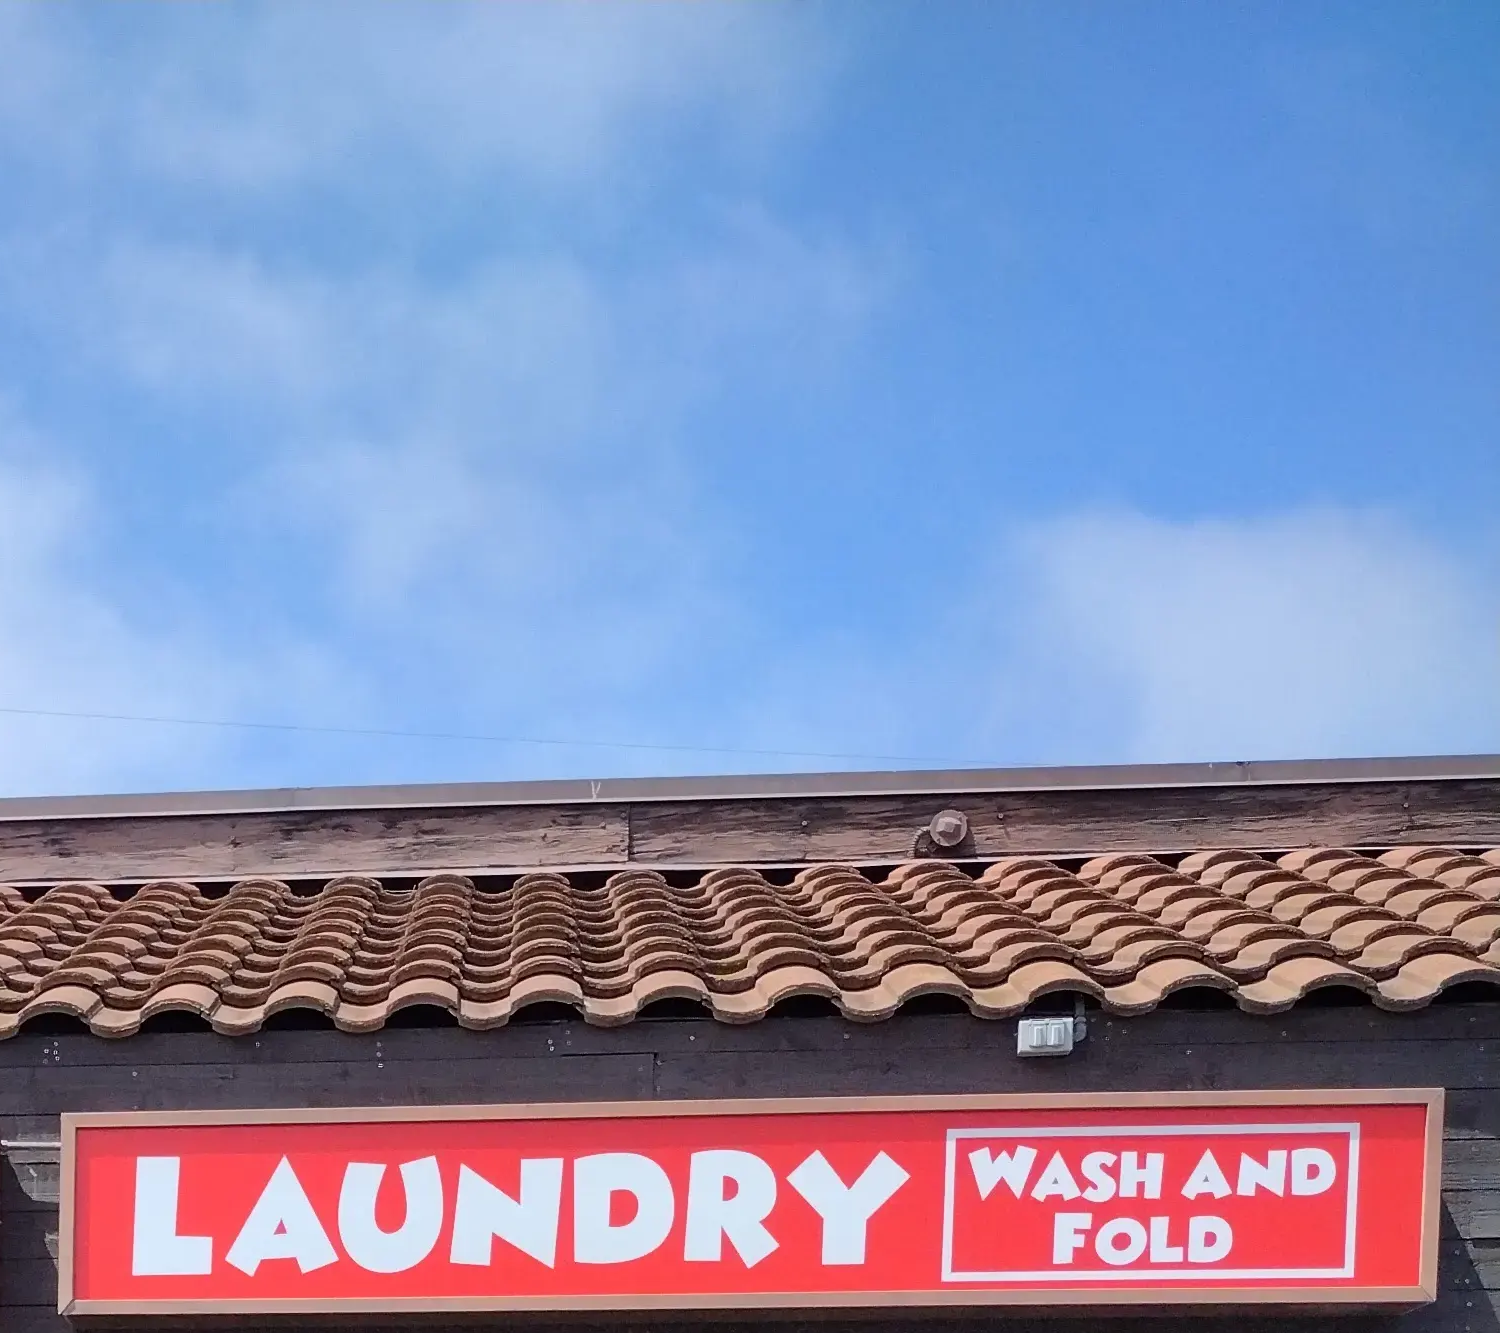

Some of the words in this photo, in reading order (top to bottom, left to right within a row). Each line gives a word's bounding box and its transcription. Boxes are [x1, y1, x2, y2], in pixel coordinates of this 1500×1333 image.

[967, 1145, 1165, 1203] WASH
[1180, 1147, 1337, 1200] AND
[131, 1149, 912, 1277] LAUNDRY
[1051, 1212, 1234, 1265] FOLD
